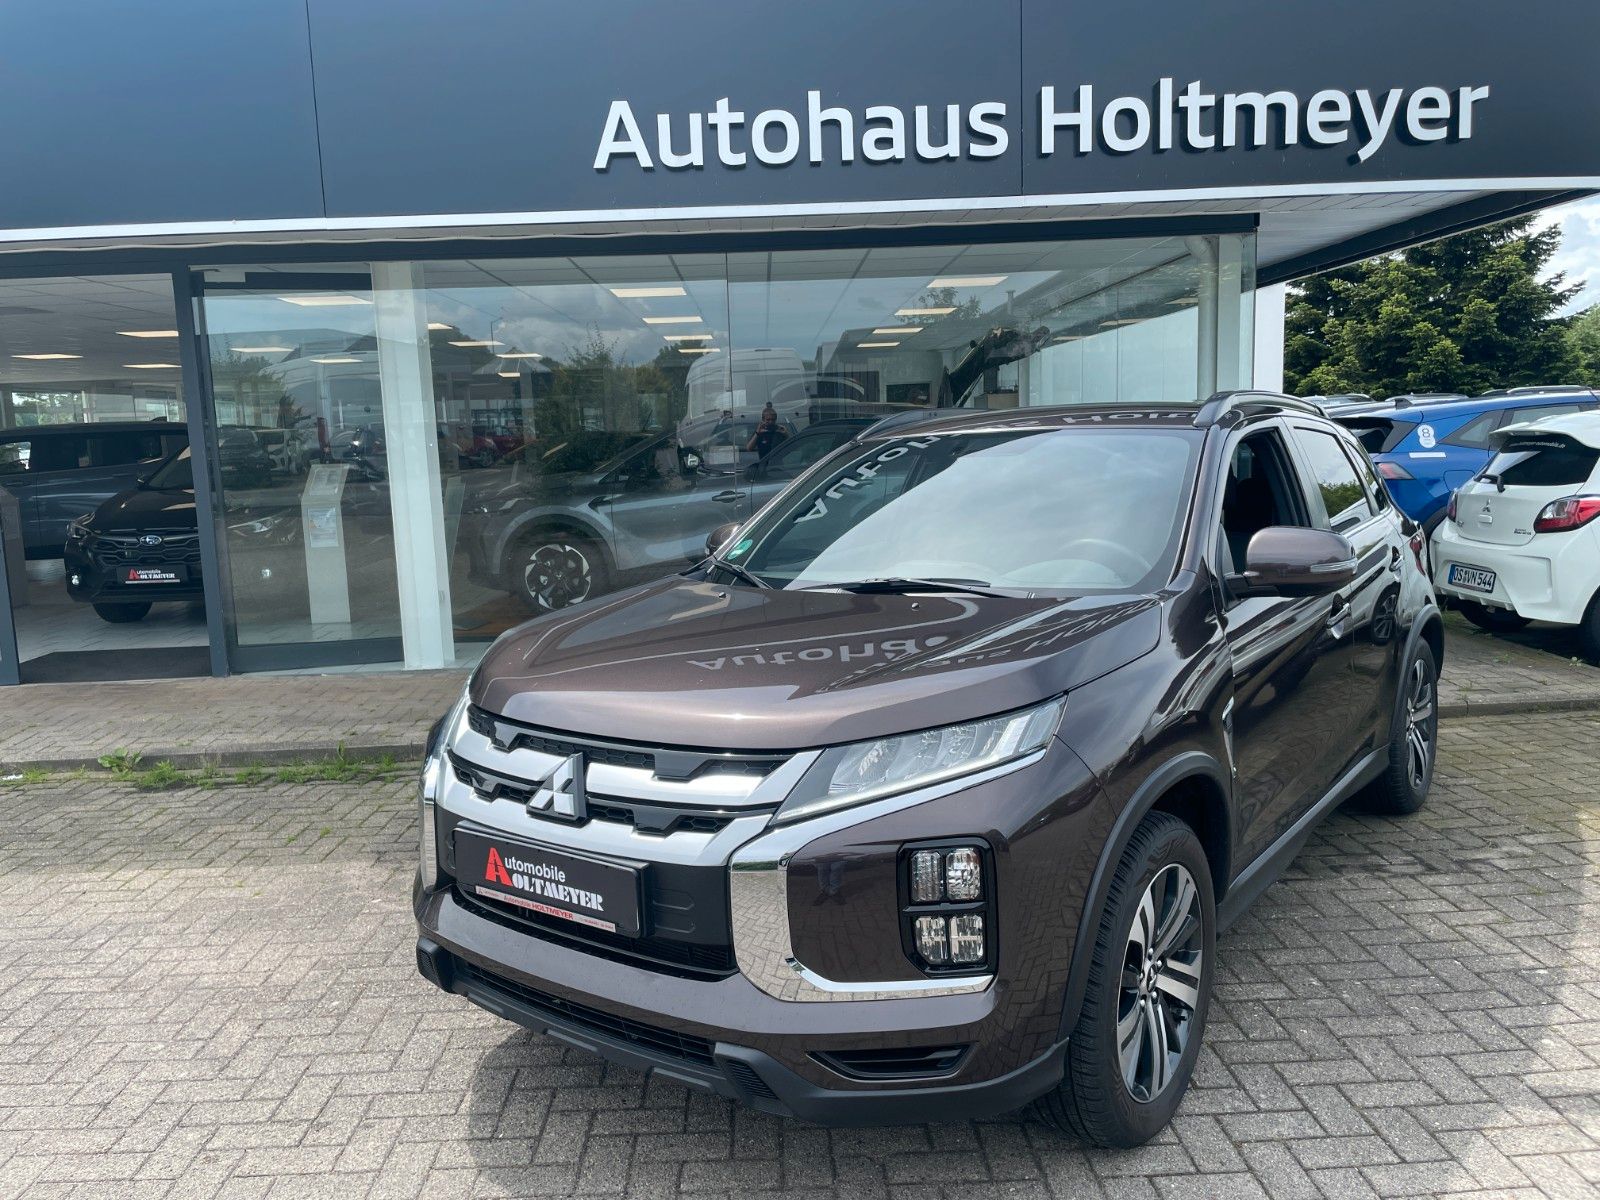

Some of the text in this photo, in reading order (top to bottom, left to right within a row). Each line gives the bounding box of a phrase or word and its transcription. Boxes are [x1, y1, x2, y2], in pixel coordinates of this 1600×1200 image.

[593, 77, 1490, 171] Autohaus Holtmeyer
[1421, 428, 1431, 438] 8
[1453, 567, 1464, 582] OS
[1477, 572, 1493, 588] 544
[531, 901, 574, 920] HOLTMEYER
